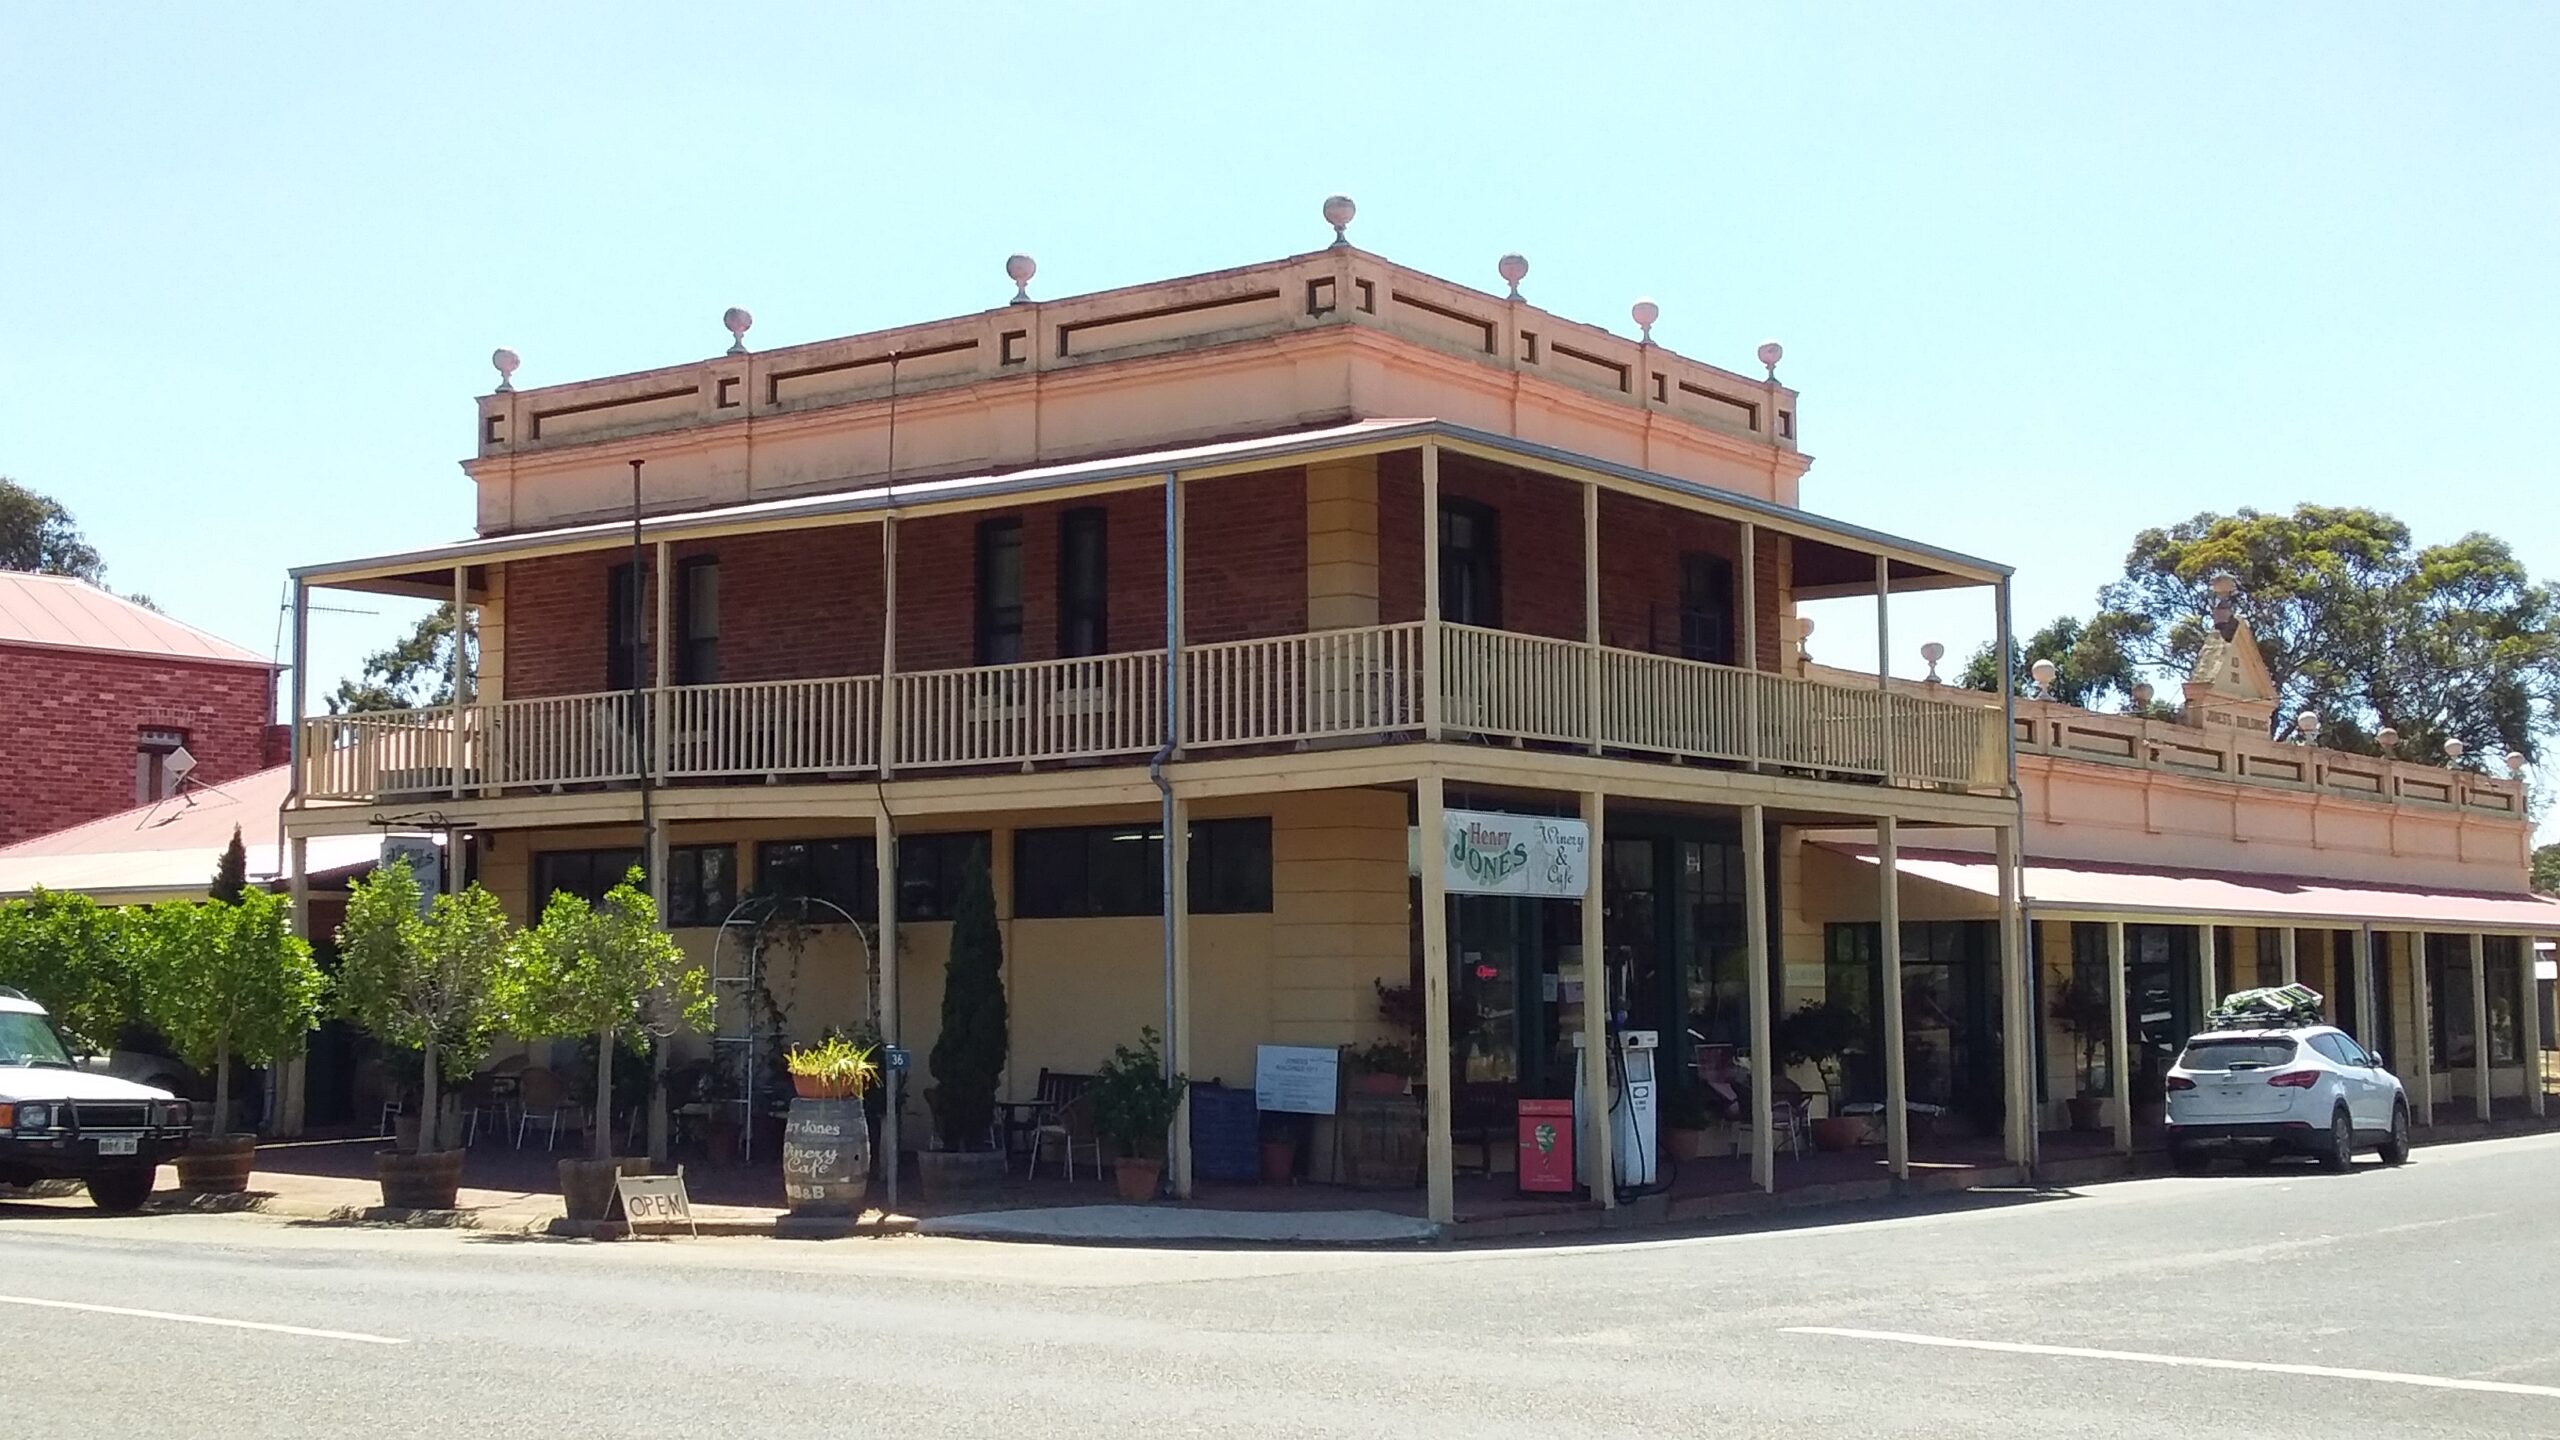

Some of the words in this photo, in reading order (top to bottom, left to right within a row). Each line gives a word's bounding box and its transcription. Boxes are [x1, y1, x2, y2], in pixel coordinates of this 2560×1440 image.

[1470, 822, 1513, 849] Henry
[1539, 826, 1584, 853] Winery
[1453, 828, 1528, 881] JONES
[1555, 846, 1568, 866] &
[891, 1053, 904, 1066] 36
[801, 1119, 841, 1136] Jones
[629, 1194, 683, 1218] OPEN
